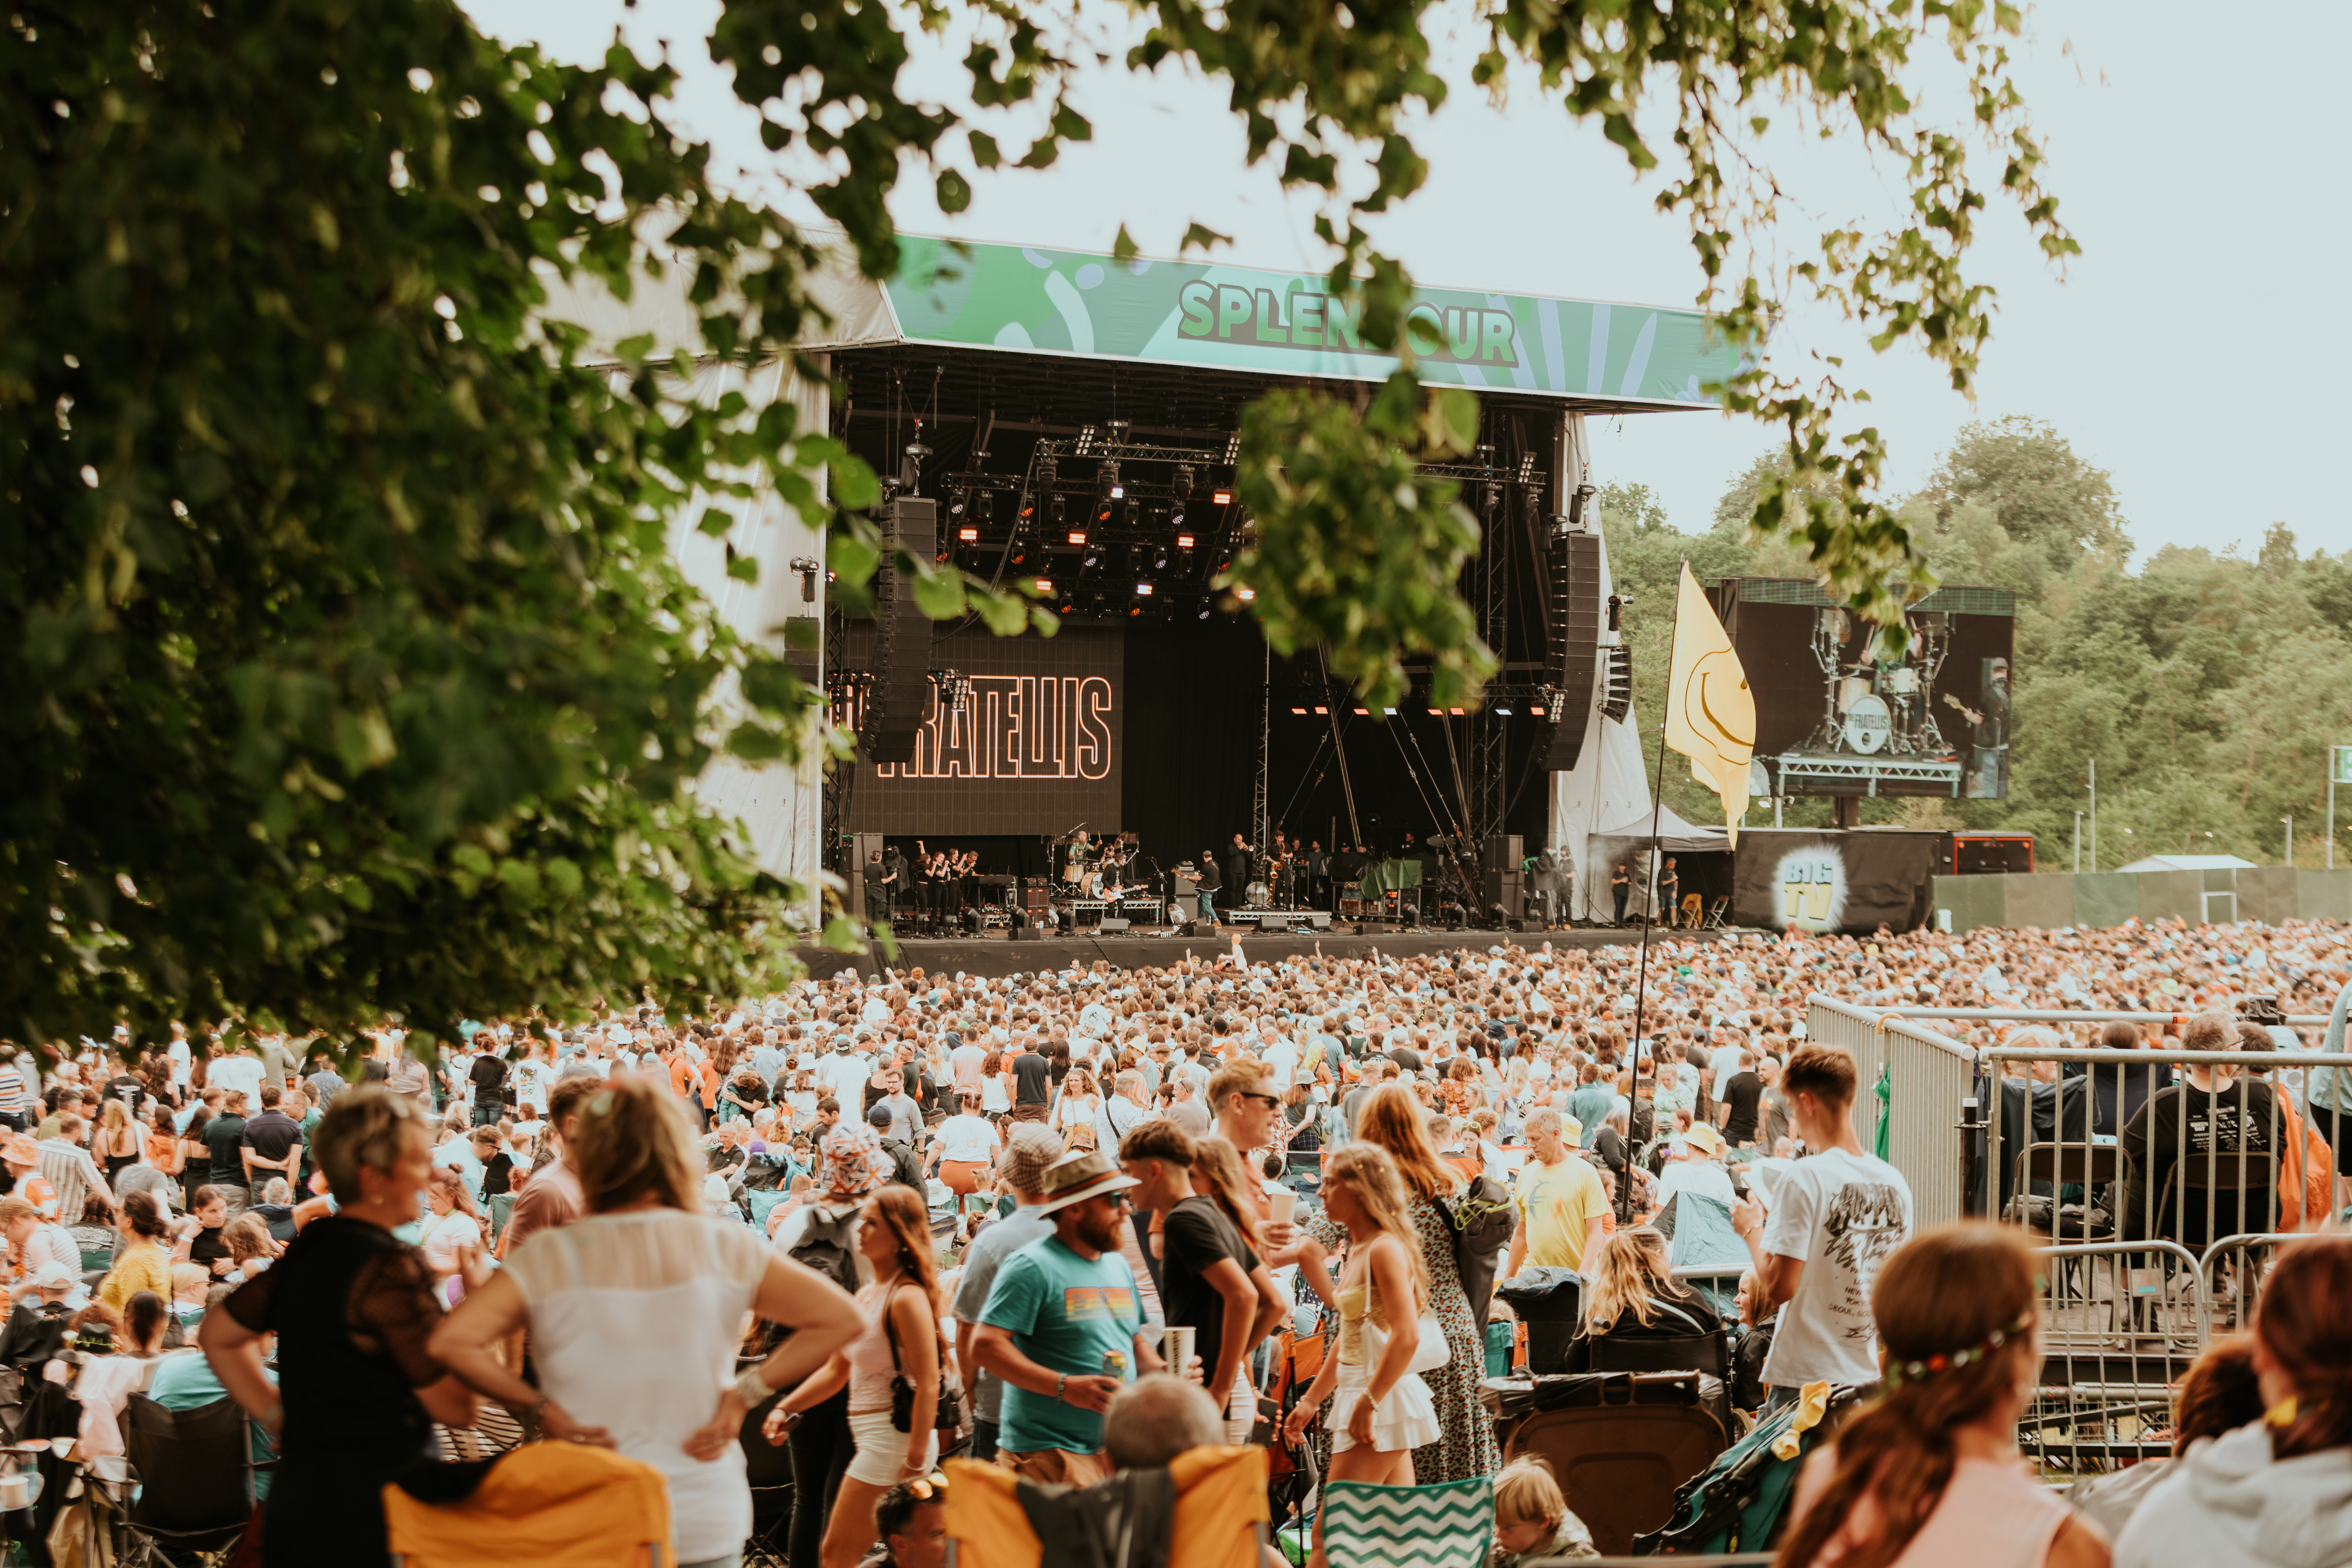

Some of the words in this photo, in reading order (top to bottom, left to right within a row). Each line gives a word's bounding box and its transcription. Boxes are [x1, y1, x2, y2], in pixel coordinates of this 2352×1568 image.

[1178, 279, 1519, 368] SPLENOUR
[878, 675, 1112, 779] RATELLIS
[1785, 861, 1832, 884] BIG
[1784, 884, 1832, 921] TV
[1856, 1310, 1872, 1318] SOU
